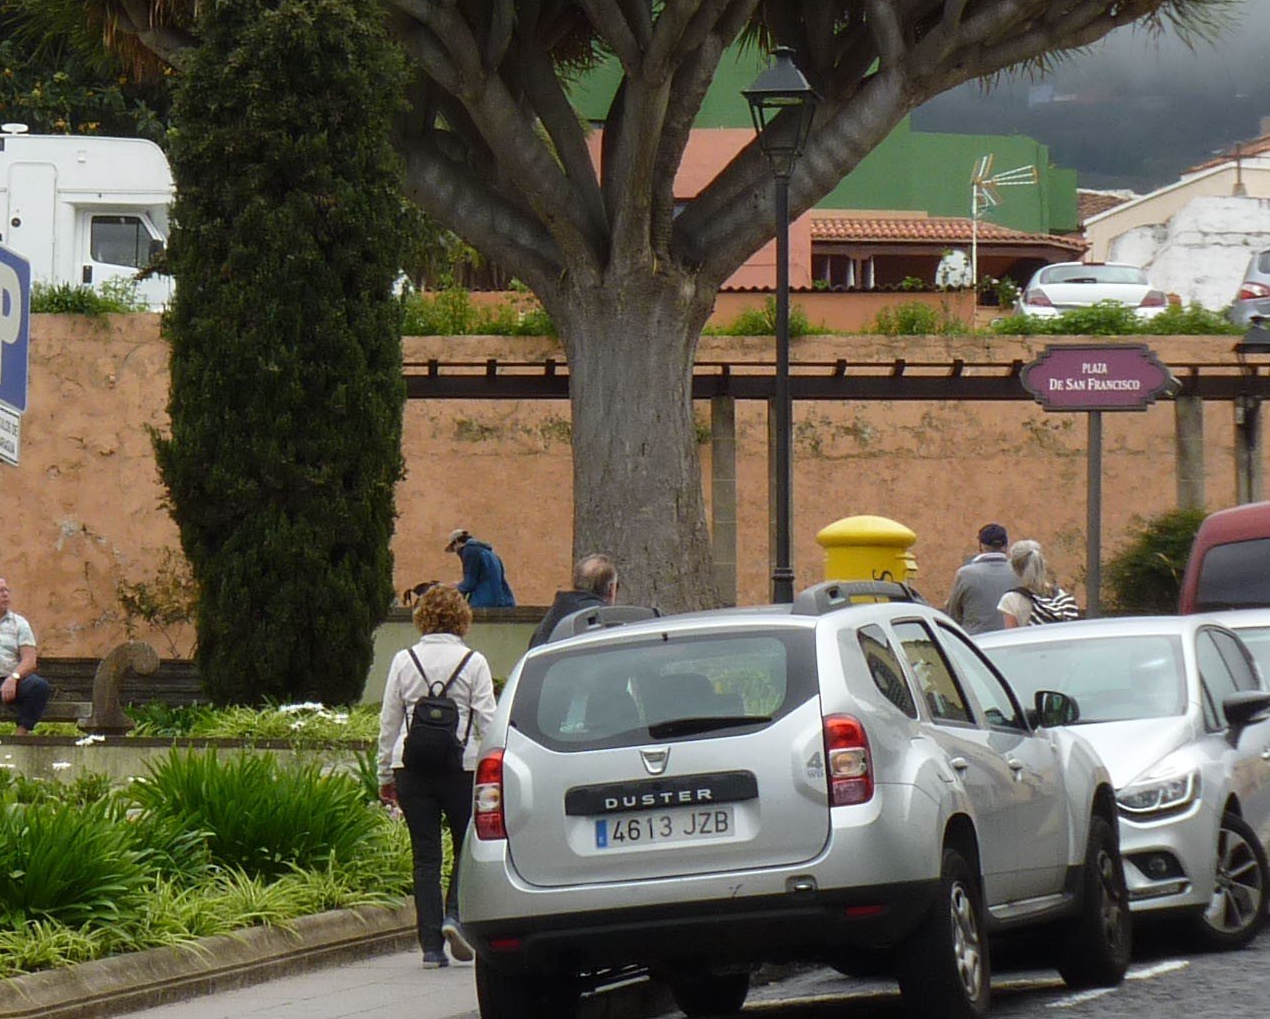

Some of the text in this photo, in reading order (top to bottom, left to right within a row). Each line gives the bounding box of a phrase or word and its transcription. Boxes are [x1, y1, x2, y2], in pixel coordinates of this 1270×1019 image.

[1082, 363, 1107, 374] PLAZA
[1049, 378, 1140, 391] DE SAN FRANCISCO
[806, 751, 824, 769] 4
[604, 788, 713, 809] DUSTER
[613, 811, 729, 842] 4613 JZB
